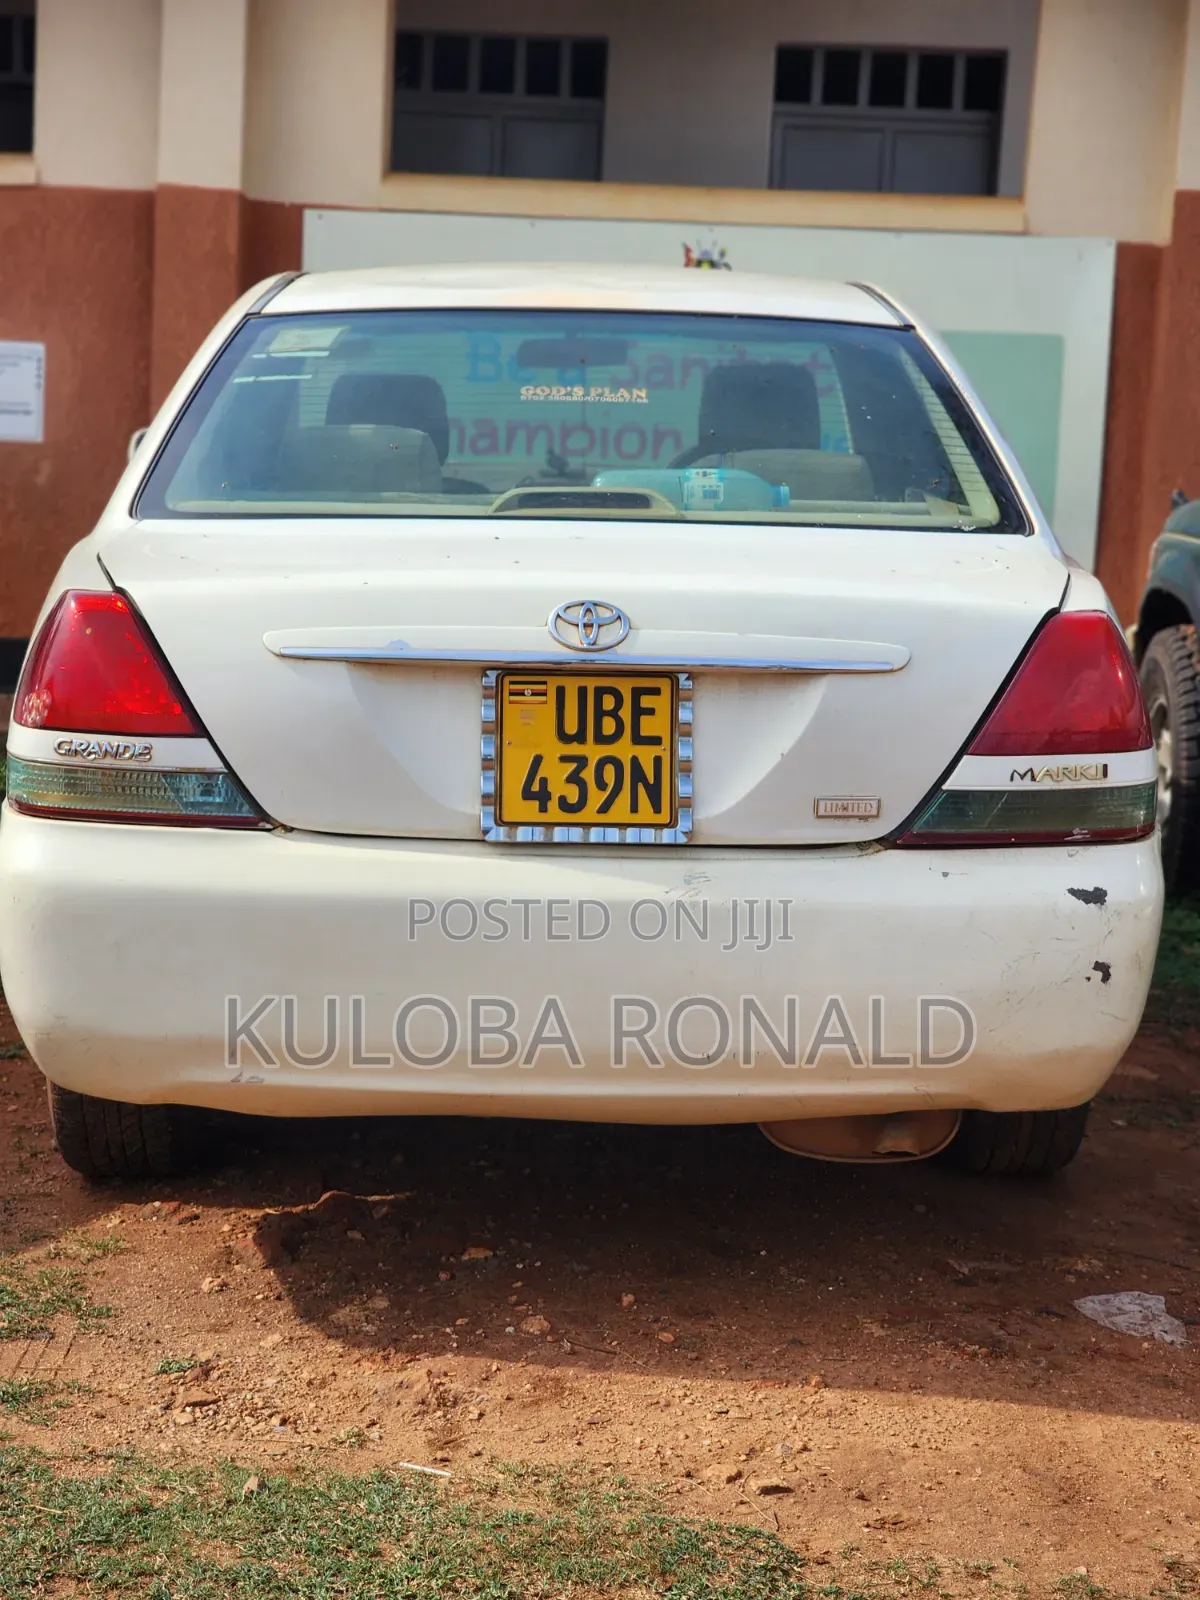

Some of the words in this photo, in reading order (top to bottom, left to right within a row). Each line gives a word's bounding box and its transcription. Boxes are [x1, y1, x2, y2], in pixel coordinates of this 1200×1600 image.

[520, 386, 585, 396] GOD'S
[589, 387, 648, 398] PLAN
[555, 685, 663, 746] UBE
[54, 738, 152, 761] GRANDE
[521, 754, 663, 814] 439N
[824, 802, 873, 813] LIMITED
